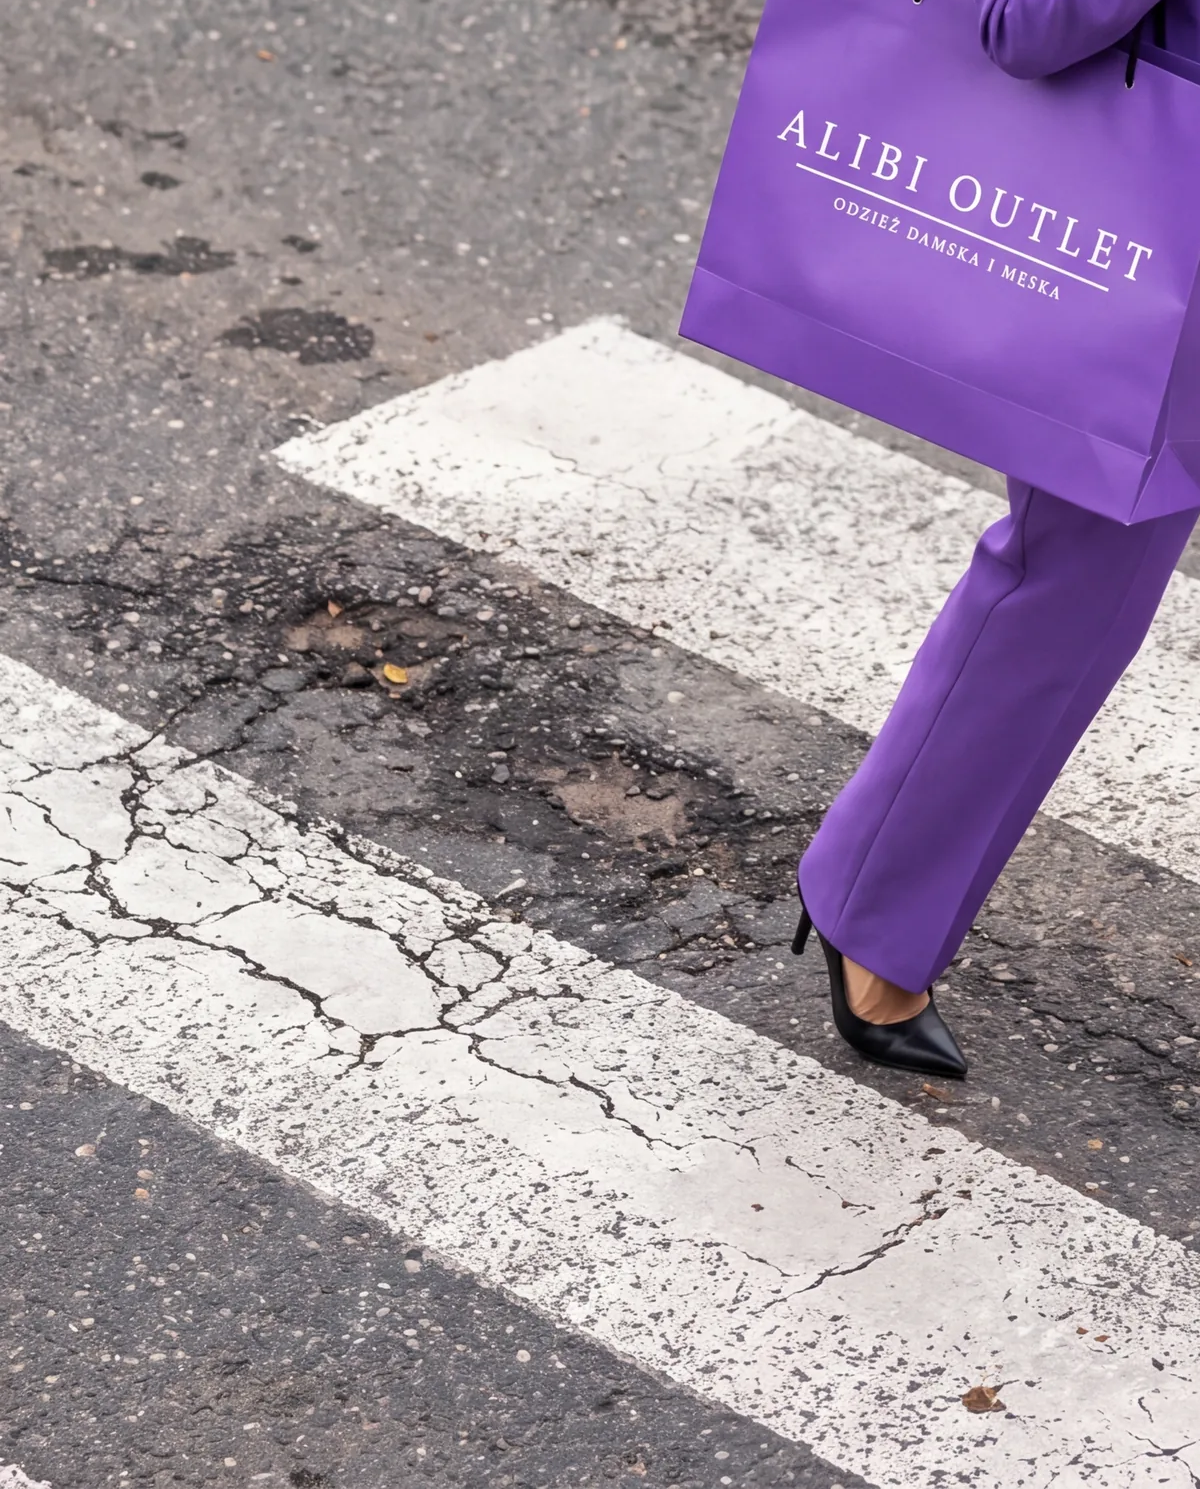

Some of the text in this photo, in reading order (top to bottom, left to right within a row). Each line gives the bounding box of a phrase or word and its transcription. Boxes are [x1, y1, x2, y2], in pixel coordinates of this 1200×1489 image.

[777, 109, 1153, 282] ALIBI OUTLET
[906, 226, 979, 267] DAMSKA
[986, 257, 996, 273] I
